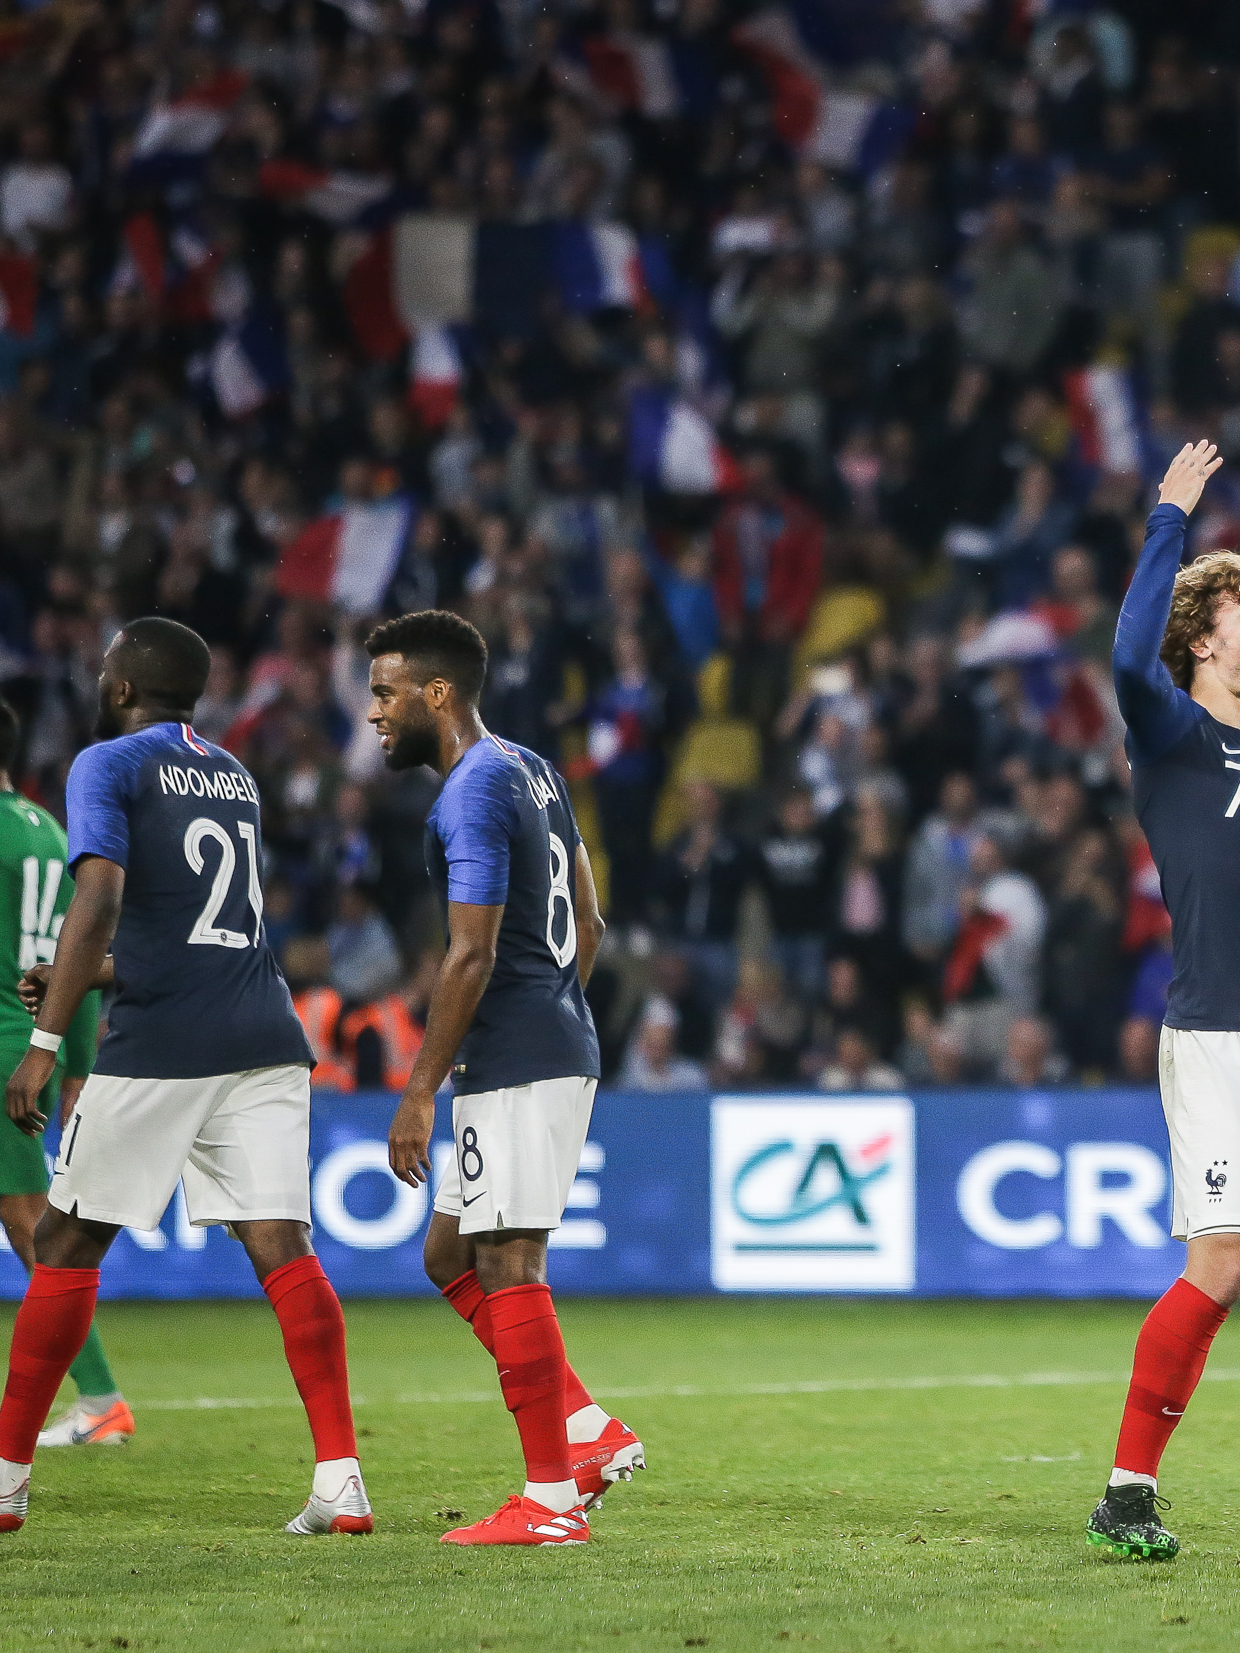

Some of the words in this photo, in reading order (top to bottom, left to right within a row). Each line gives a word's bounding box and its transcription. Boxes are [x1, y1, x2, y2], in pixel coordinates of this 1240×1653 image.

[183, 817, 264, 949] 21
[546, 832, 577, 969] 8
[462, 1126, 484, 1182] 8
